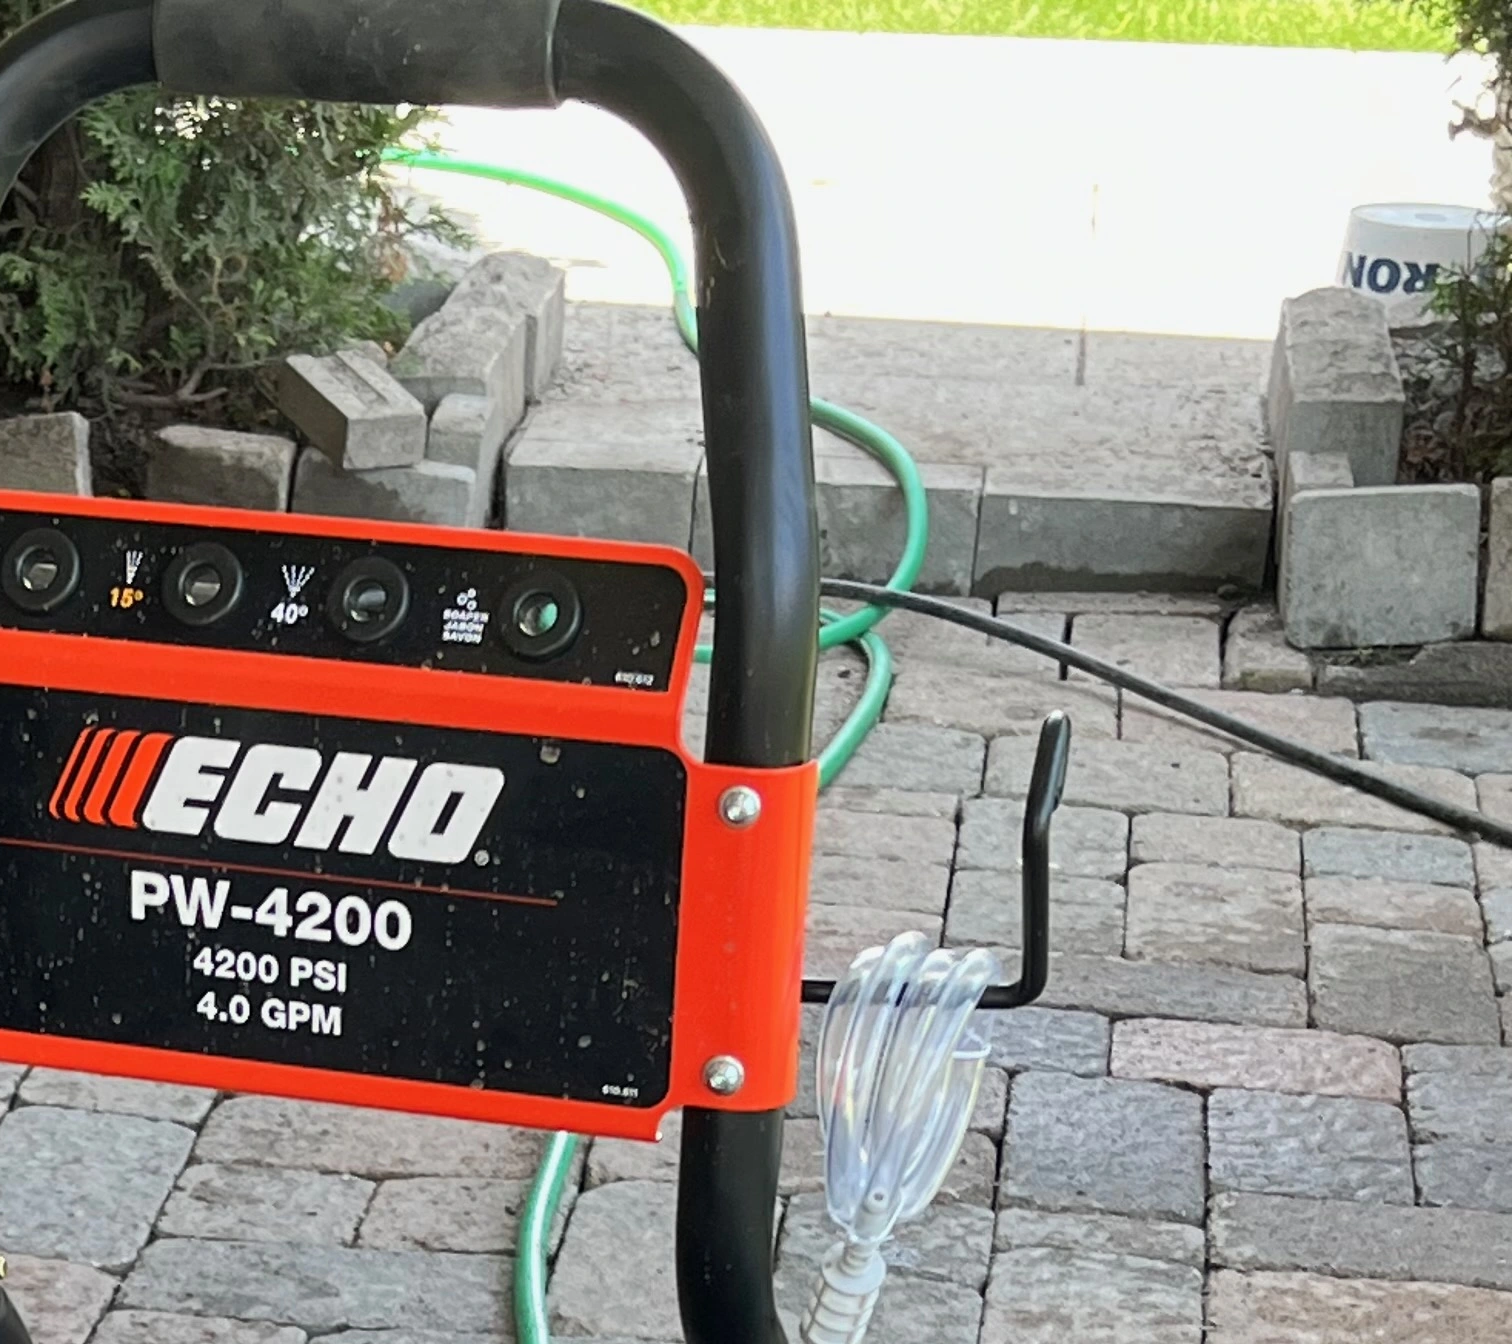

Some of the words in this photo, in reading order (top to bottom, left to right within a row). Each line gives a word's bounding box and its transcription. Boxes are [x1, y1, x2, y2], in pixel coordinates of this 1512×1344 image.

[270, 602, 309, 625] 40°
[143, 736, 504, 864] ECHO
[131, 870, 412, 951] PW-4200
[193, 946, 279, 984] 4200
[290, 957, 347, 993] PSI
[196, 991, 250, 1024] 4.0
[261, 999, 342, 1036] GPM
